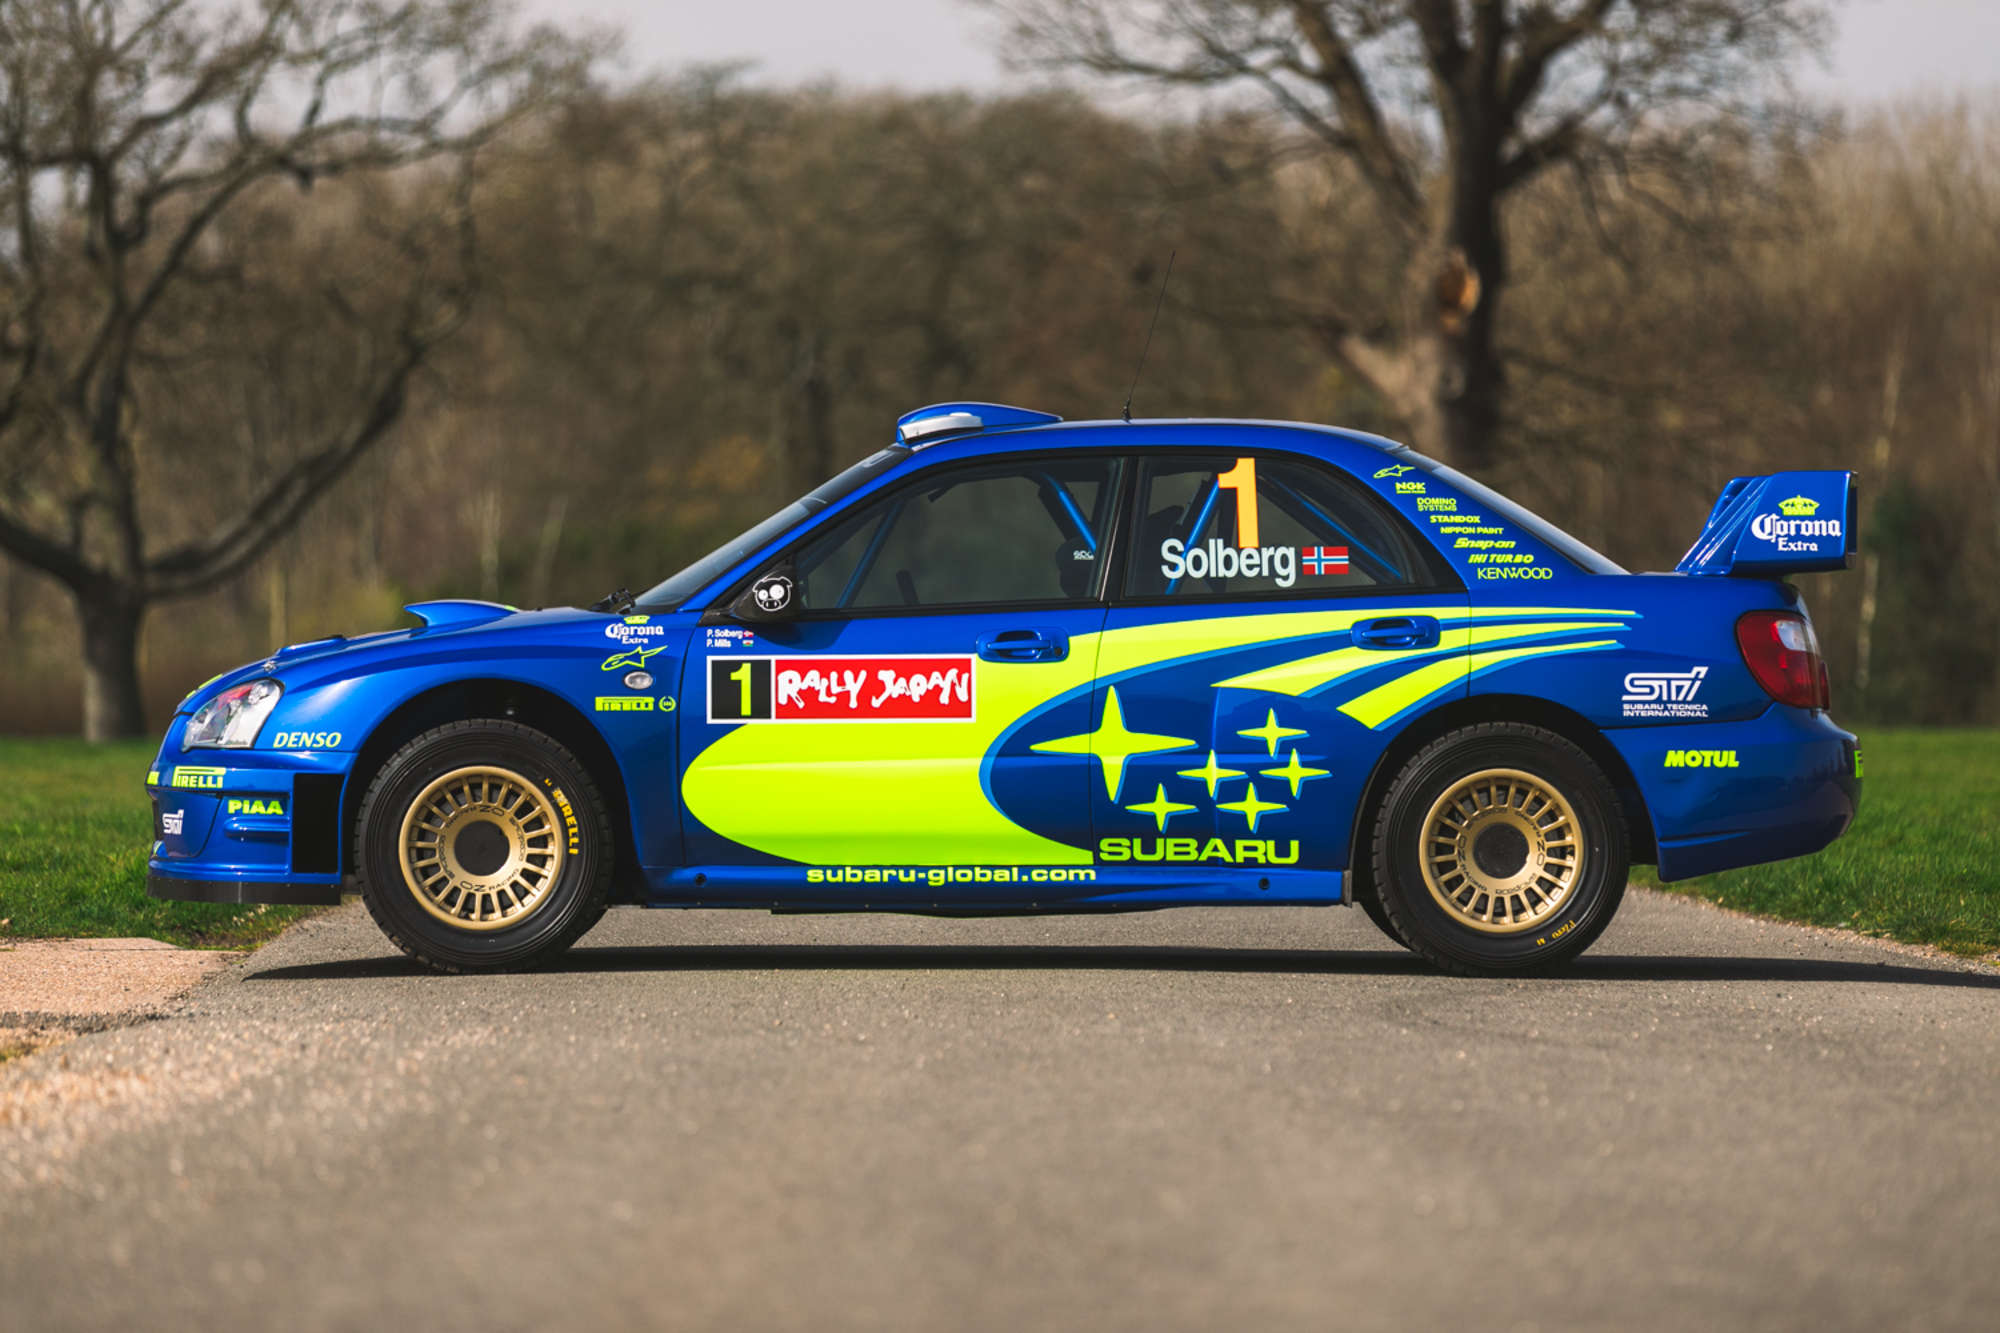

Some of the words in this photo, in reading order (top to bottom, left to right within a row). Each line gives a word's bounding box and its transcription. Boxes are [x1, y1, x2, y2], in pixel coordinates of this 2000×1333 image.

[1395, 482, 1426, 490] NGK
[1217, 457, 1259, 548] 1
[1416, 497, 1457, 505] DOMINO
[1417, 504, 1458, 512] SYSTEMS
[1430, 515, 1481, 523] STANDOX
[1440, 526, 1476, 535] NIPPON
[1476, 526, 1504, 535] PAINT
[1751, 513, 1842, 543] Corona
[1453, 537, 1517, 550] Snap-on
[1777, 537, 1819, 552] Extra
[1160, 537, 1297, 588] Solberg
[1467, 554, 1490, 564] IHI
[1489, 554, 1535, 564] TURBO
[1477, 567, 1553, 580] KENWOOD
[605, 622, 665, 640] Corona
[621, 636, 649, 645] Extra
[729, 661, 752, 716] 1
[777, 669, 867, 709] RALLY
[871, 667, 970, 709] JAPAN
[1622, 703, 1665, 711] SUBARU
[1665, 703, 1709, 711] TECNICA
[1622, 710, 1709, 718] INTERNATIONAL
[272, 731, 342, 748] DENSO
[1664, 750, 1740, 768] MOTUL
[172, 766, 227, 789] PIRELLI
[227, 799, 284, 815] PIAA
[552, 787, 579, 855] PIRELLI
[1100, 837, 1300, 865] SUBARU
[806, 865, 1097, 887] subaru-global.com
